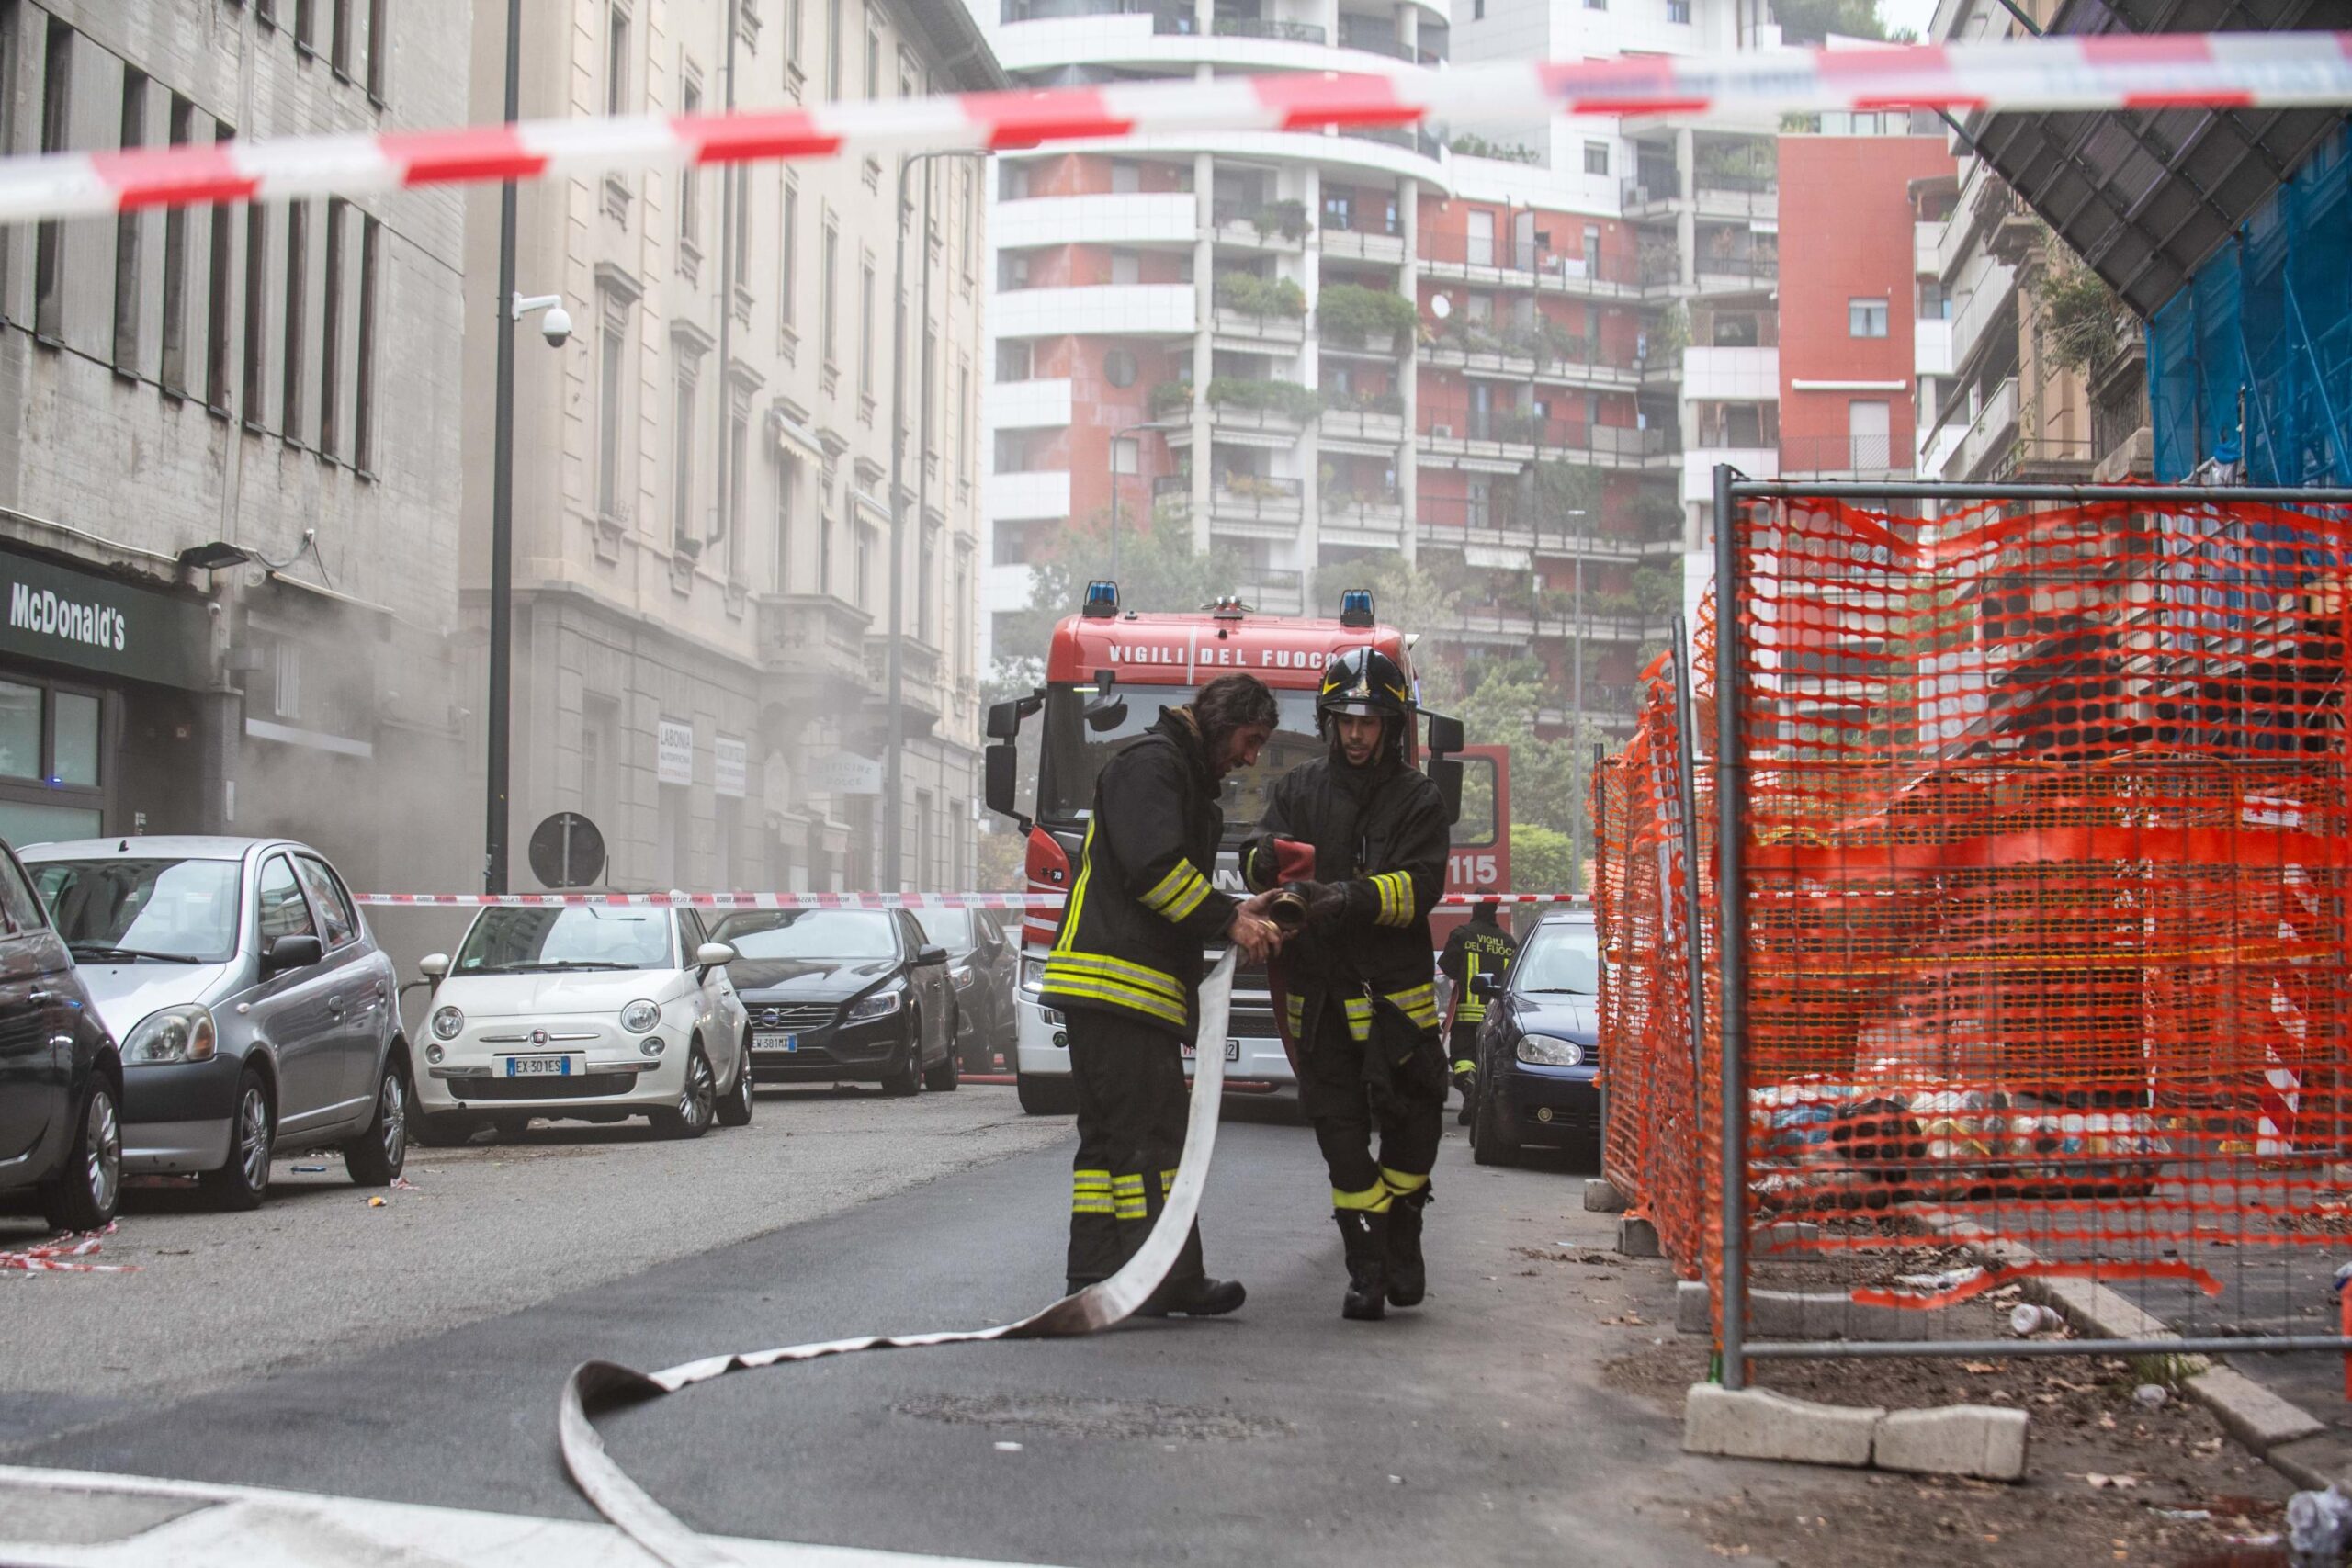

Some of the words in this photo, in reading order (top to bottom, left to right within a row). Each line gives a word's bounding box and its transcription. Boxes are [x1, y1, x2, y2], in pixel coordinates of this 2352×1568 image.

[10, 581, 125, 651] McDonald's
[1109, 646, 1183, 663] VIGILI
[1200, 648, 1247, 666] DEL
[1261, 649, 1339, 670] FUOCO
[1449, 855, 1498, 884] 115
[1464, 941, 1483, 953] DEL
[1487, 944, 1515, 956] FUOC
[1476, 933, 1504, 947] VIGILI
